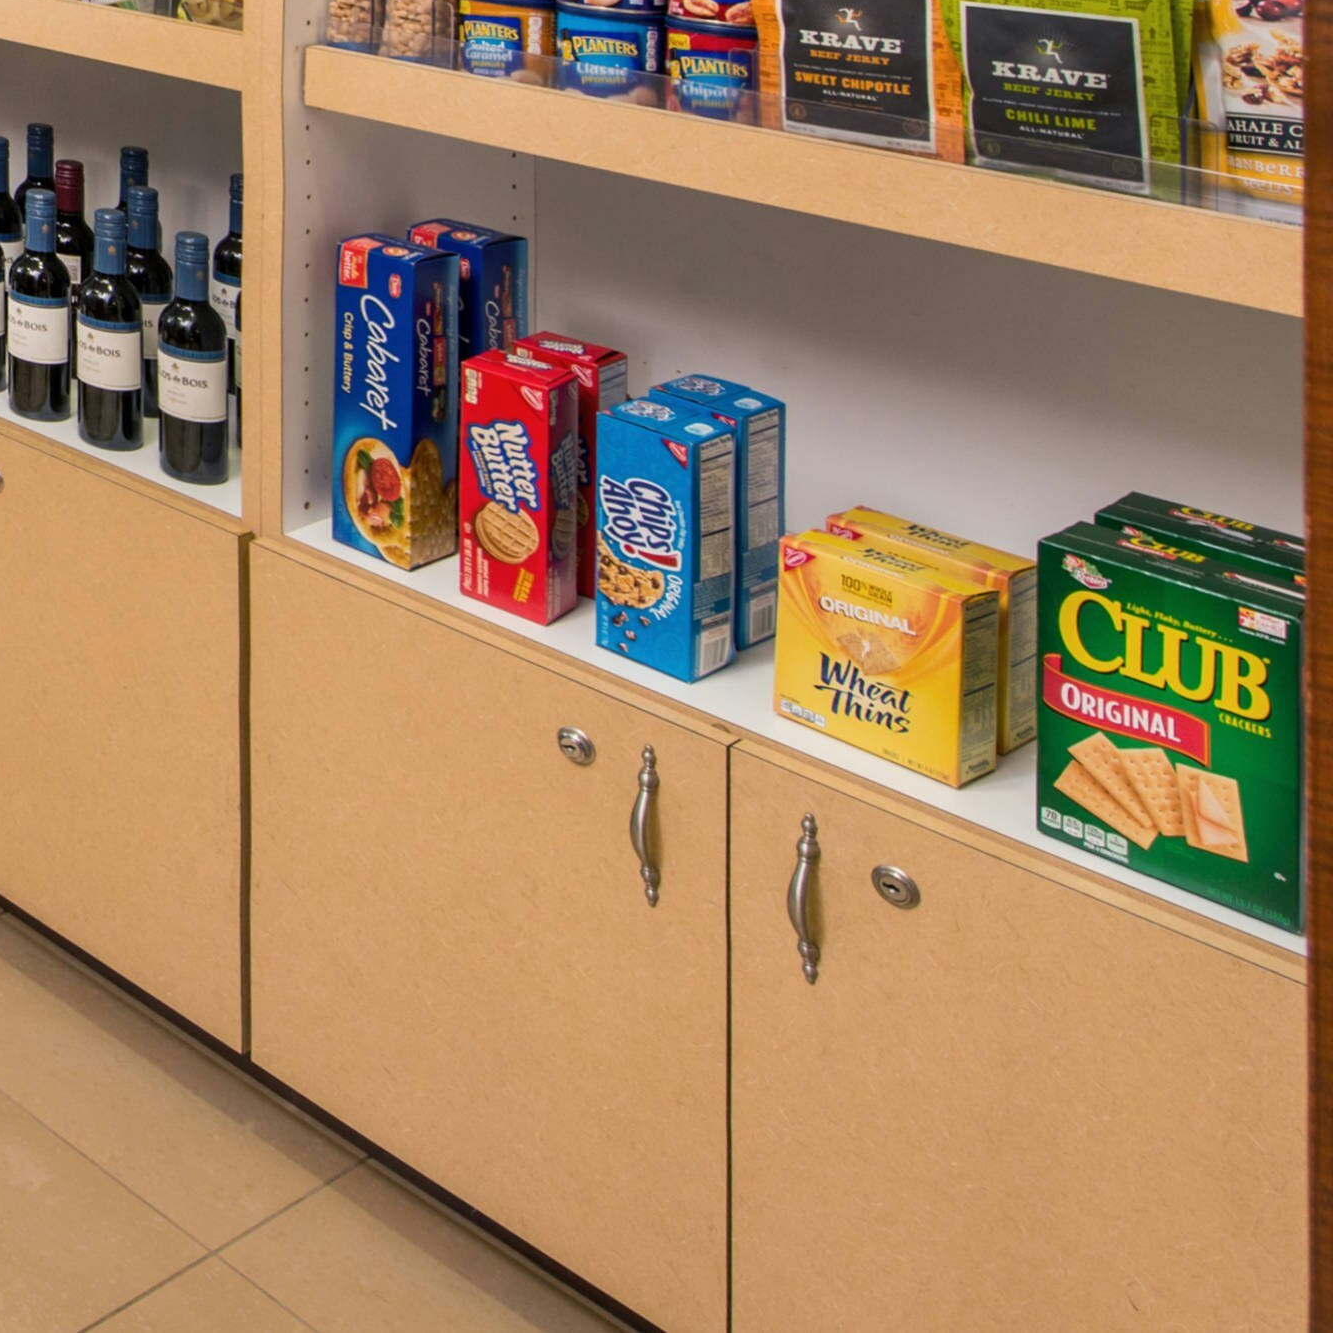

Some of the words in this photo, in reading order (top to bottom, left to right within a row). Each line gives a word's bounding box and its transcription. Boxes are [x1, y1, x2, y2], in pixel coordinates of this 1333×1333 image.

[464, 22, 519, 40] PLANTERS
[799, 29, 902, 54] KRAVE
[465, 48, 512, 61] Caramel
[572, 36, 638, 56] PLANTERS
[810, 50, 842, 60] BEEF
[846, 53, 890, 66] JERKY
[680, 56, 749, 78] PLANTERS
[992, 61, 1108, 89] KRAVE
[795, 71, 836, 87] SWEET
[841, 76, 911, 95] CHIPOTLE
[1004, 83, 1040, 94] BEEF
[1045, 88, 1095, 102] JERKY
[1006, 109, 1050, 126] CHILI
[1055, 115, 1097, 131] LIME
[24, 319, 49, 332] BOIS
[344, 311, 353, 341] Crisp
[96, 346, 121, 358] BOIS
[359, 294, 399, 430] Cabaret
[415, 317, 431, 396] Cabaret
[181, 376, 208, 389] BOIS
[341, 354, 353, 394] Buttery
[471, 425, 519, 513] Butter
[494, 422, 538, 511] Nutter
[627, 480, 671, 554] Chips
[649, 574, 682, 620] ORIGINAL
[820, 595, 916, 636] ORIGINAL
[1058, 589, 1272, 722] CLUB
[818, 651, 913, 712] Wheat
[814, 684, 910, 734] Thins
[1060, 682, 1181, 744] ORIGINAL
[1219, 712, 1272, 739] CRACKERS
